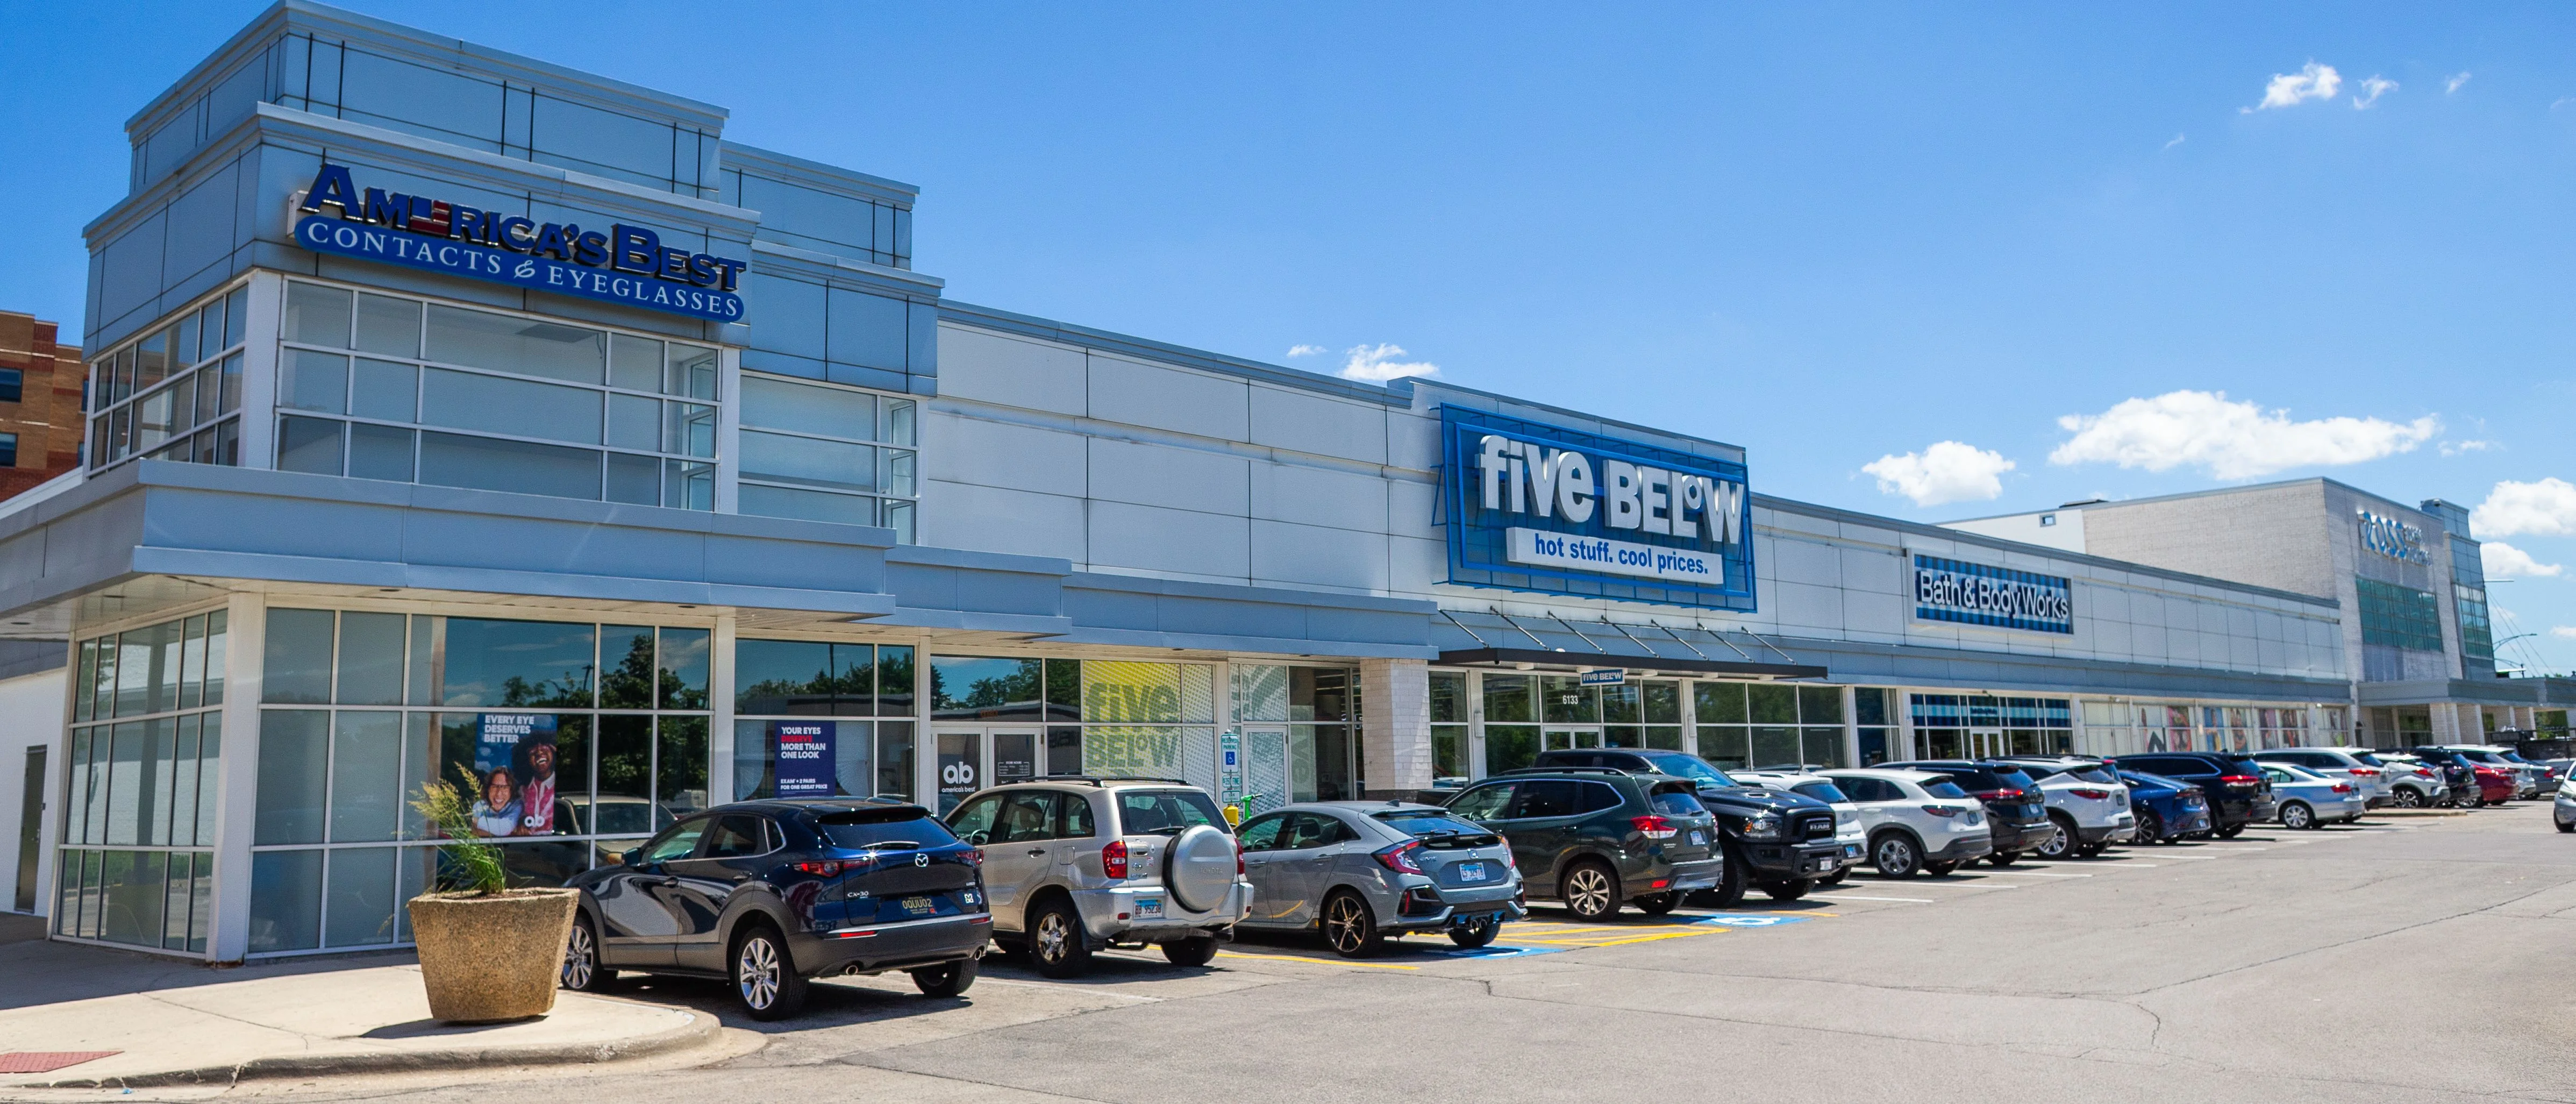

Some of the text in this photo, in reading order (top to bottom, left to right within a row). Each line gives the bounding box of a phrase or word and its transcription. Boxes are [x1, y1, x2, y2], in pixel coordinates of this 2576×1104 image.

[299, 163, 747, 291] AMERICA'S BEST
[308, 222, 737, 316] CONTACTS & EYEGLASSES
[1475, 435, 1744, 544] five BELOW
[1535, 533, 1708, 574] hot stuff. cool prices.
[1920, 571, 2068, 618] Bath & Body Works
[1599, 672, 1622, 680] BELOW
[1086, 682, 1179, 732] five
[1562, 695, 1579, 705] 6133
[484, 724, 531, 734] DESERVES
[485, 715, 534, 725] EVERY EYE
[484, 734, 519, 743] BETTER
[1086, 735, 1178, 767] BELOW
[943, 761, 974, 784] ab
[524, 814, 545, 827] ab
